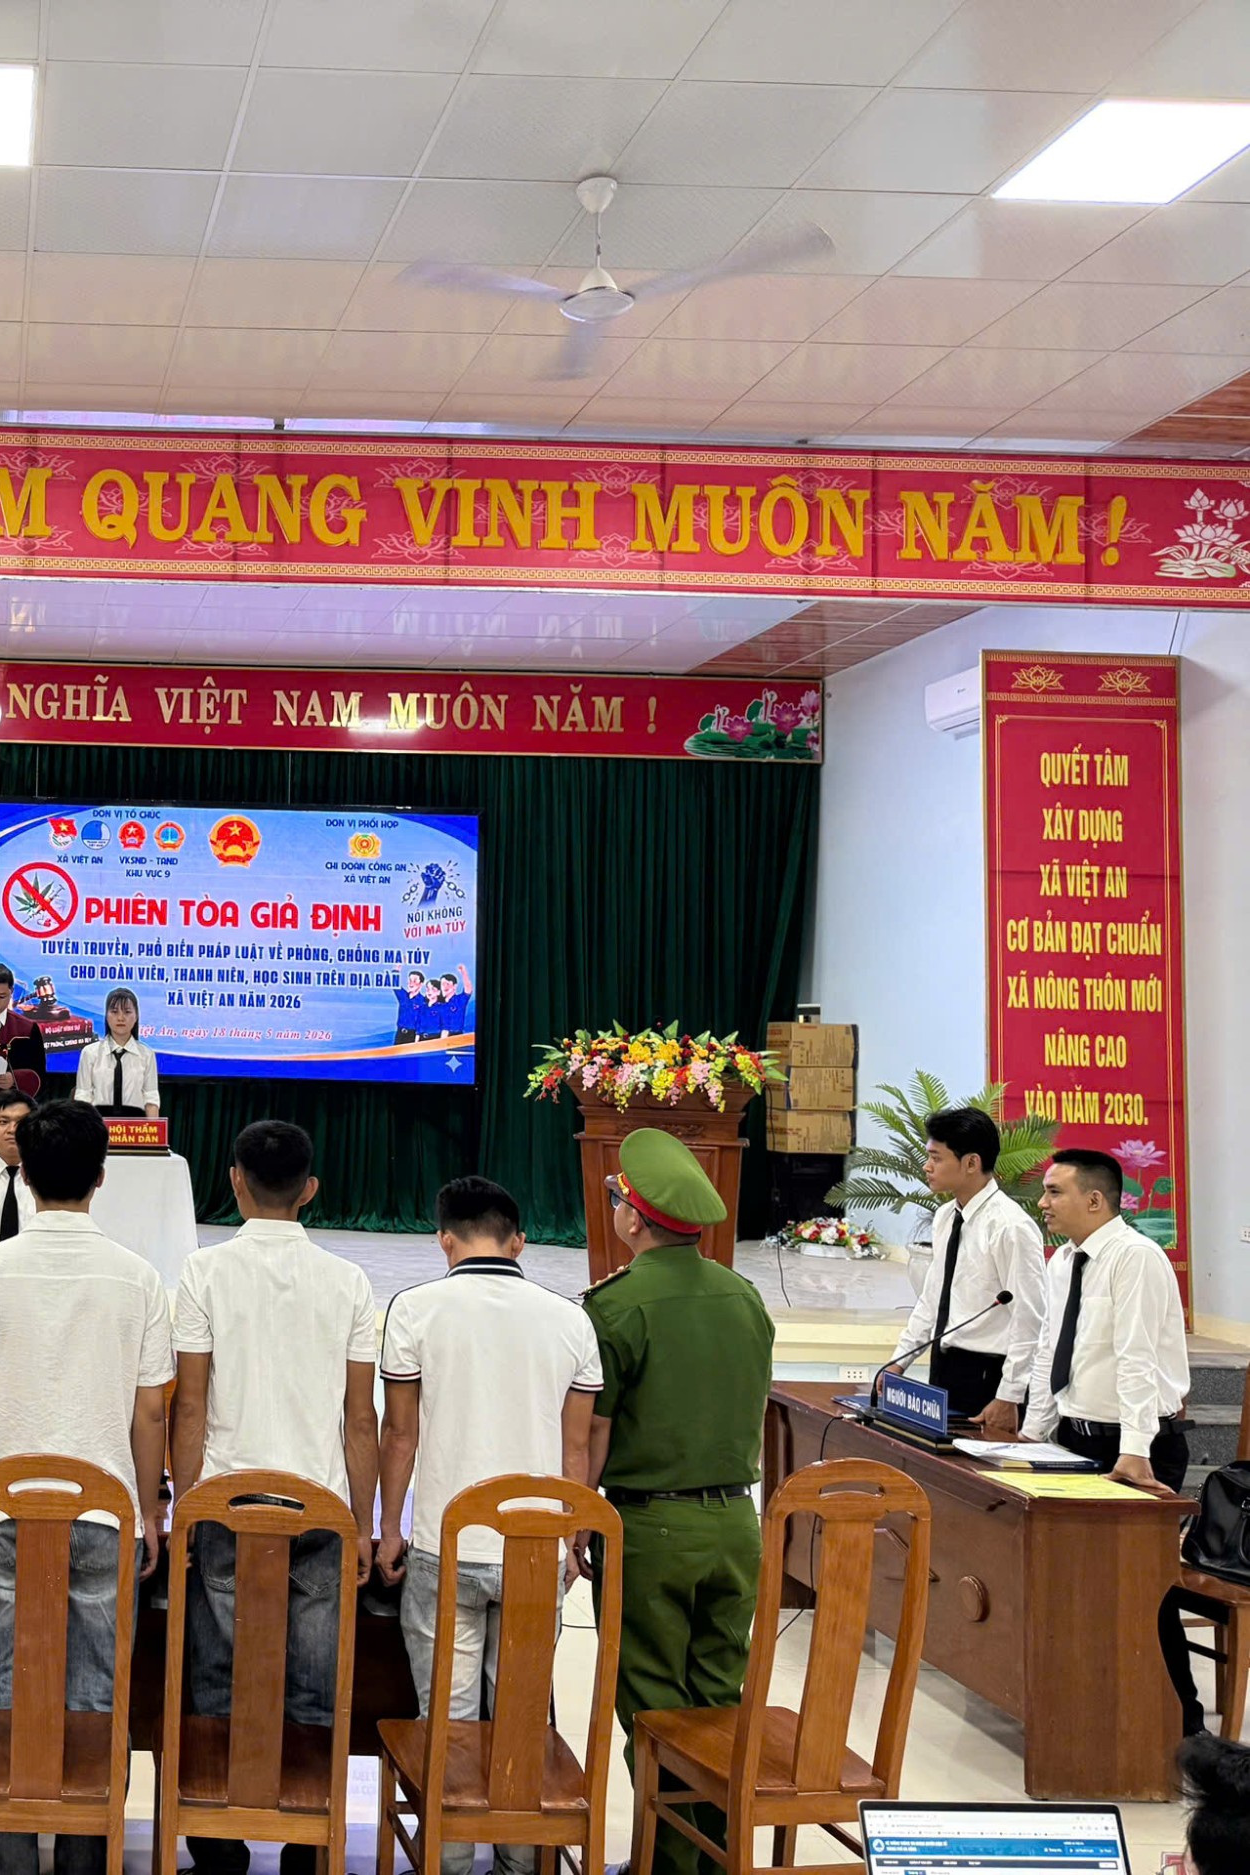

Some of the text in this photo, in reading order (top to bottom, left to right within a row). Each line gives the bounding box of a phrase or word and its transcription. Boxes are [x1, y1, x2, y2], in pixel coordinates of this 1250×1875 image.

[82, 470, 366, 547] QUANG
[396, 479, 603, 551] VINH
[628, 476, 869, 559] MUÔN
[898, 481, 1085, 564] NĂM
[1102, 497, 1126, 565] !
[1, 675, 131, 724] NGHĨA
[155, 677, 246, 733] VIỆT
[273, 691, 367, 733] NAM
[383, 682, 508, 735] MUÔN
[533, 685, 623, 731] NĂM
[650, 698, 656, 732] !
[1041, 746, 1128, 787] QUYẾT TÂM
[1043, 804, 1122, 848] XÂY DỰNG
[91, 856, 103, 864] AN
[126, 869, 143, 878] KHU
[164, 870, 171, 878] 9
[325, 862, 338, 870] CHI
[394, 863, 407, 871] AN
[378, 876, 391, 884] AN
[1040, 861, 1127, 904] XÃ VIỆT AN
[85, 892, 382, 937] PHIÊN TÒA GIẢ ĐỊNH
[425, 924, 442, 936] MA
[41, 938, 79, 955] TUYÊN
[137, 937, 162, 957] PHỔ
[166, 938, 194, 958] BIẾN
[198, 942, 231, 959] PHÁP
[235, 943, 264, 962] LUẬT
[268, 941, 283, 960] VỀ
[287, 944, 333, 964] PHÒNG,
[337, 943, 380, 963] CHỐNG
[384, 950, 401, 964] MA
[407, 947, 431, 965] TÚY
[1007, 912, 1161, 960] CƠ BẢN ĐẠT CHUẨN
[70, 965, 96, 979] CHO
[138, 964, 169, 983] VIÊN,
[174, 968, 213, 982] THANH
[217, 966, 248, 985] NIÊN,
[253, 970, 279, 987] HỌC
[282, 970, 312, 985] SINH
[316, 969, 345, 986] TRÊN
[1008, 971, 1162, 1012] XÃ NÔNG THÔN MỚI
[168, 989, 301, 1009] XÃ VIỆT AN NĂM 2026
[139, 1026, 155, 1038] iệt
[213, 1027, 225, 1037] 18
[266, 1028, 273, 1038] 5
[304, 1030, 332, 1040] 2026
[1045, 1028, 1126, 1067] NÂNG CAO
[1062, 1086, 1099, 1123] NĂM
[1105, 1093, 1148, 1125] 2030.
[109, 1124, 126, 1134] HỘI
